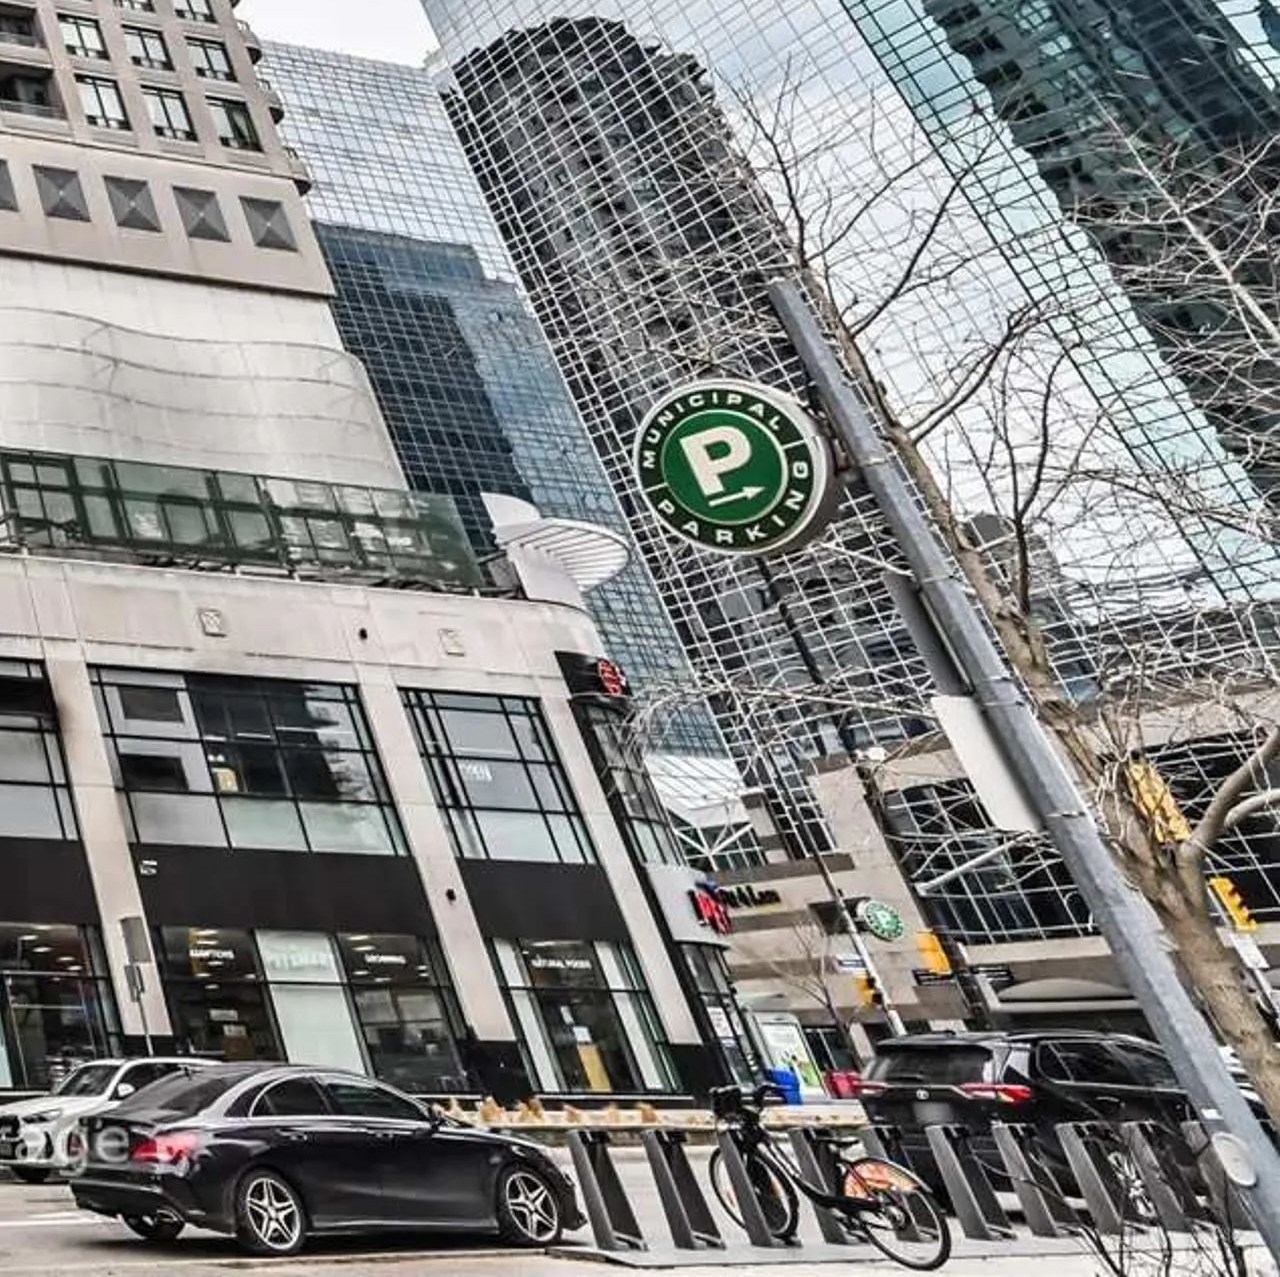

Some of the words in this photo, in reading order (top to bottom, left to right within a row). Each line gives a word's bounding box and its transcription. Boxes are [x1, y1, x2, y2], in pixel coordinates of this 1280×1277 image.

[643, 394, 782, 470] MUNICIPAL
[679, 425, 753, 498] P
[657, 460, 809, 545] PARKING
